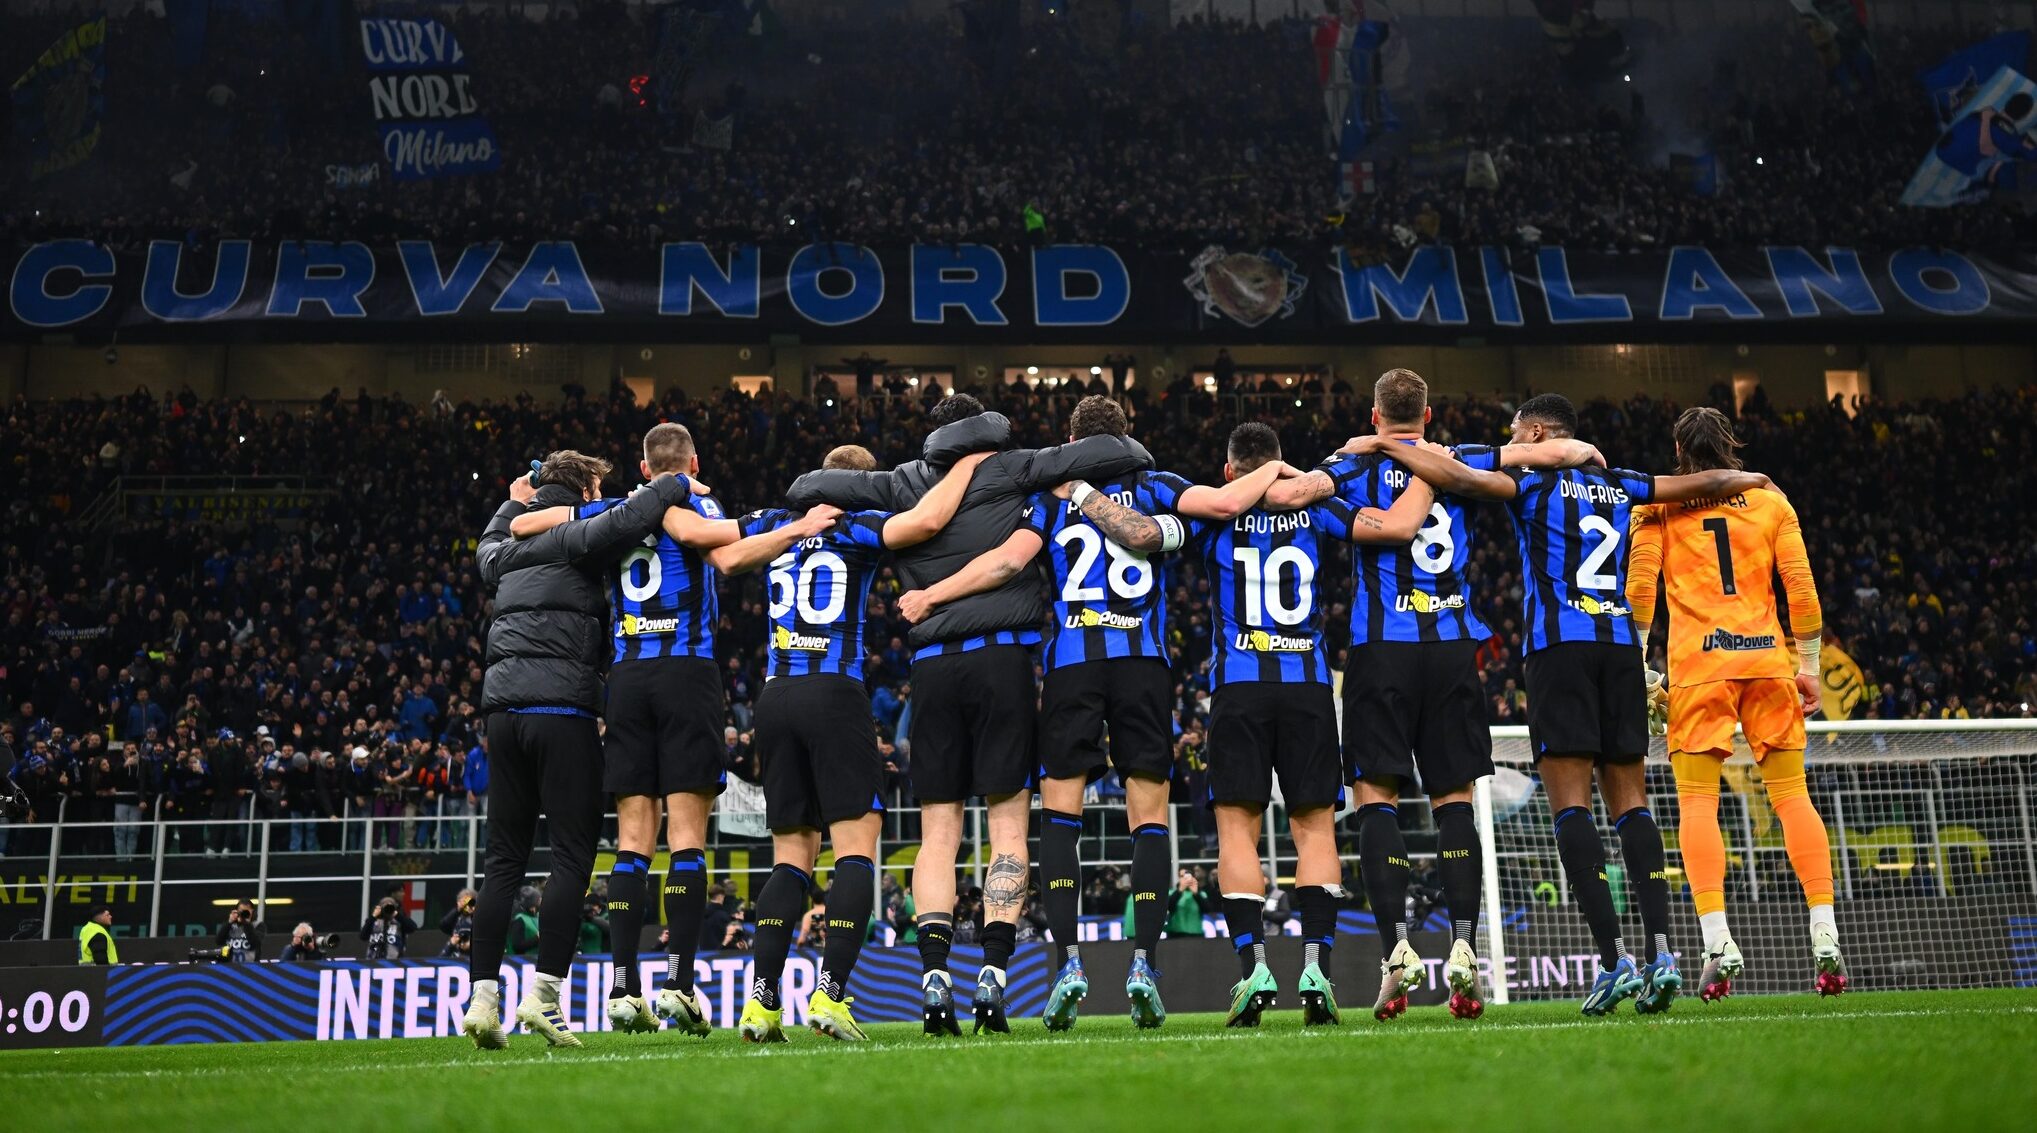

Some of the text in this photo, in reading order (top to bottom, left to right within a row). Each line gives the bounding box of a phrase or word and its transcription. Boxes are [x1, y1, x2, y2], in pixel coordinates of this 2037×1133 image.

[384, 128, 496, 175] Milano
[10, 239, 1991, 326] CURVA NORD MILANO
[1560, 479, 1629, 504] DUMFRIES
[1235, 510, 1311, 534] LAUTARO
[1411, 502, 1455, 574] 8
[1054, 523, 1153, 602] 28
[1576, 515, 1621, 590] 2
[1702, 517, 1737, 596] 1
[768, 550, 848, 625] 30
[1233, 545, 1315, 627] 10
[1442, 849, 1470, 859] INTER
[1050, 879, 1075, 889] INTER
[1135, 892, 1156, 902] INTER
[758, 919, 784, 927] INTER
[829, 919, 855, 929] INTER
[0, 990, 90, 1034] :00
[316, 965, 473, 1041] INTER
